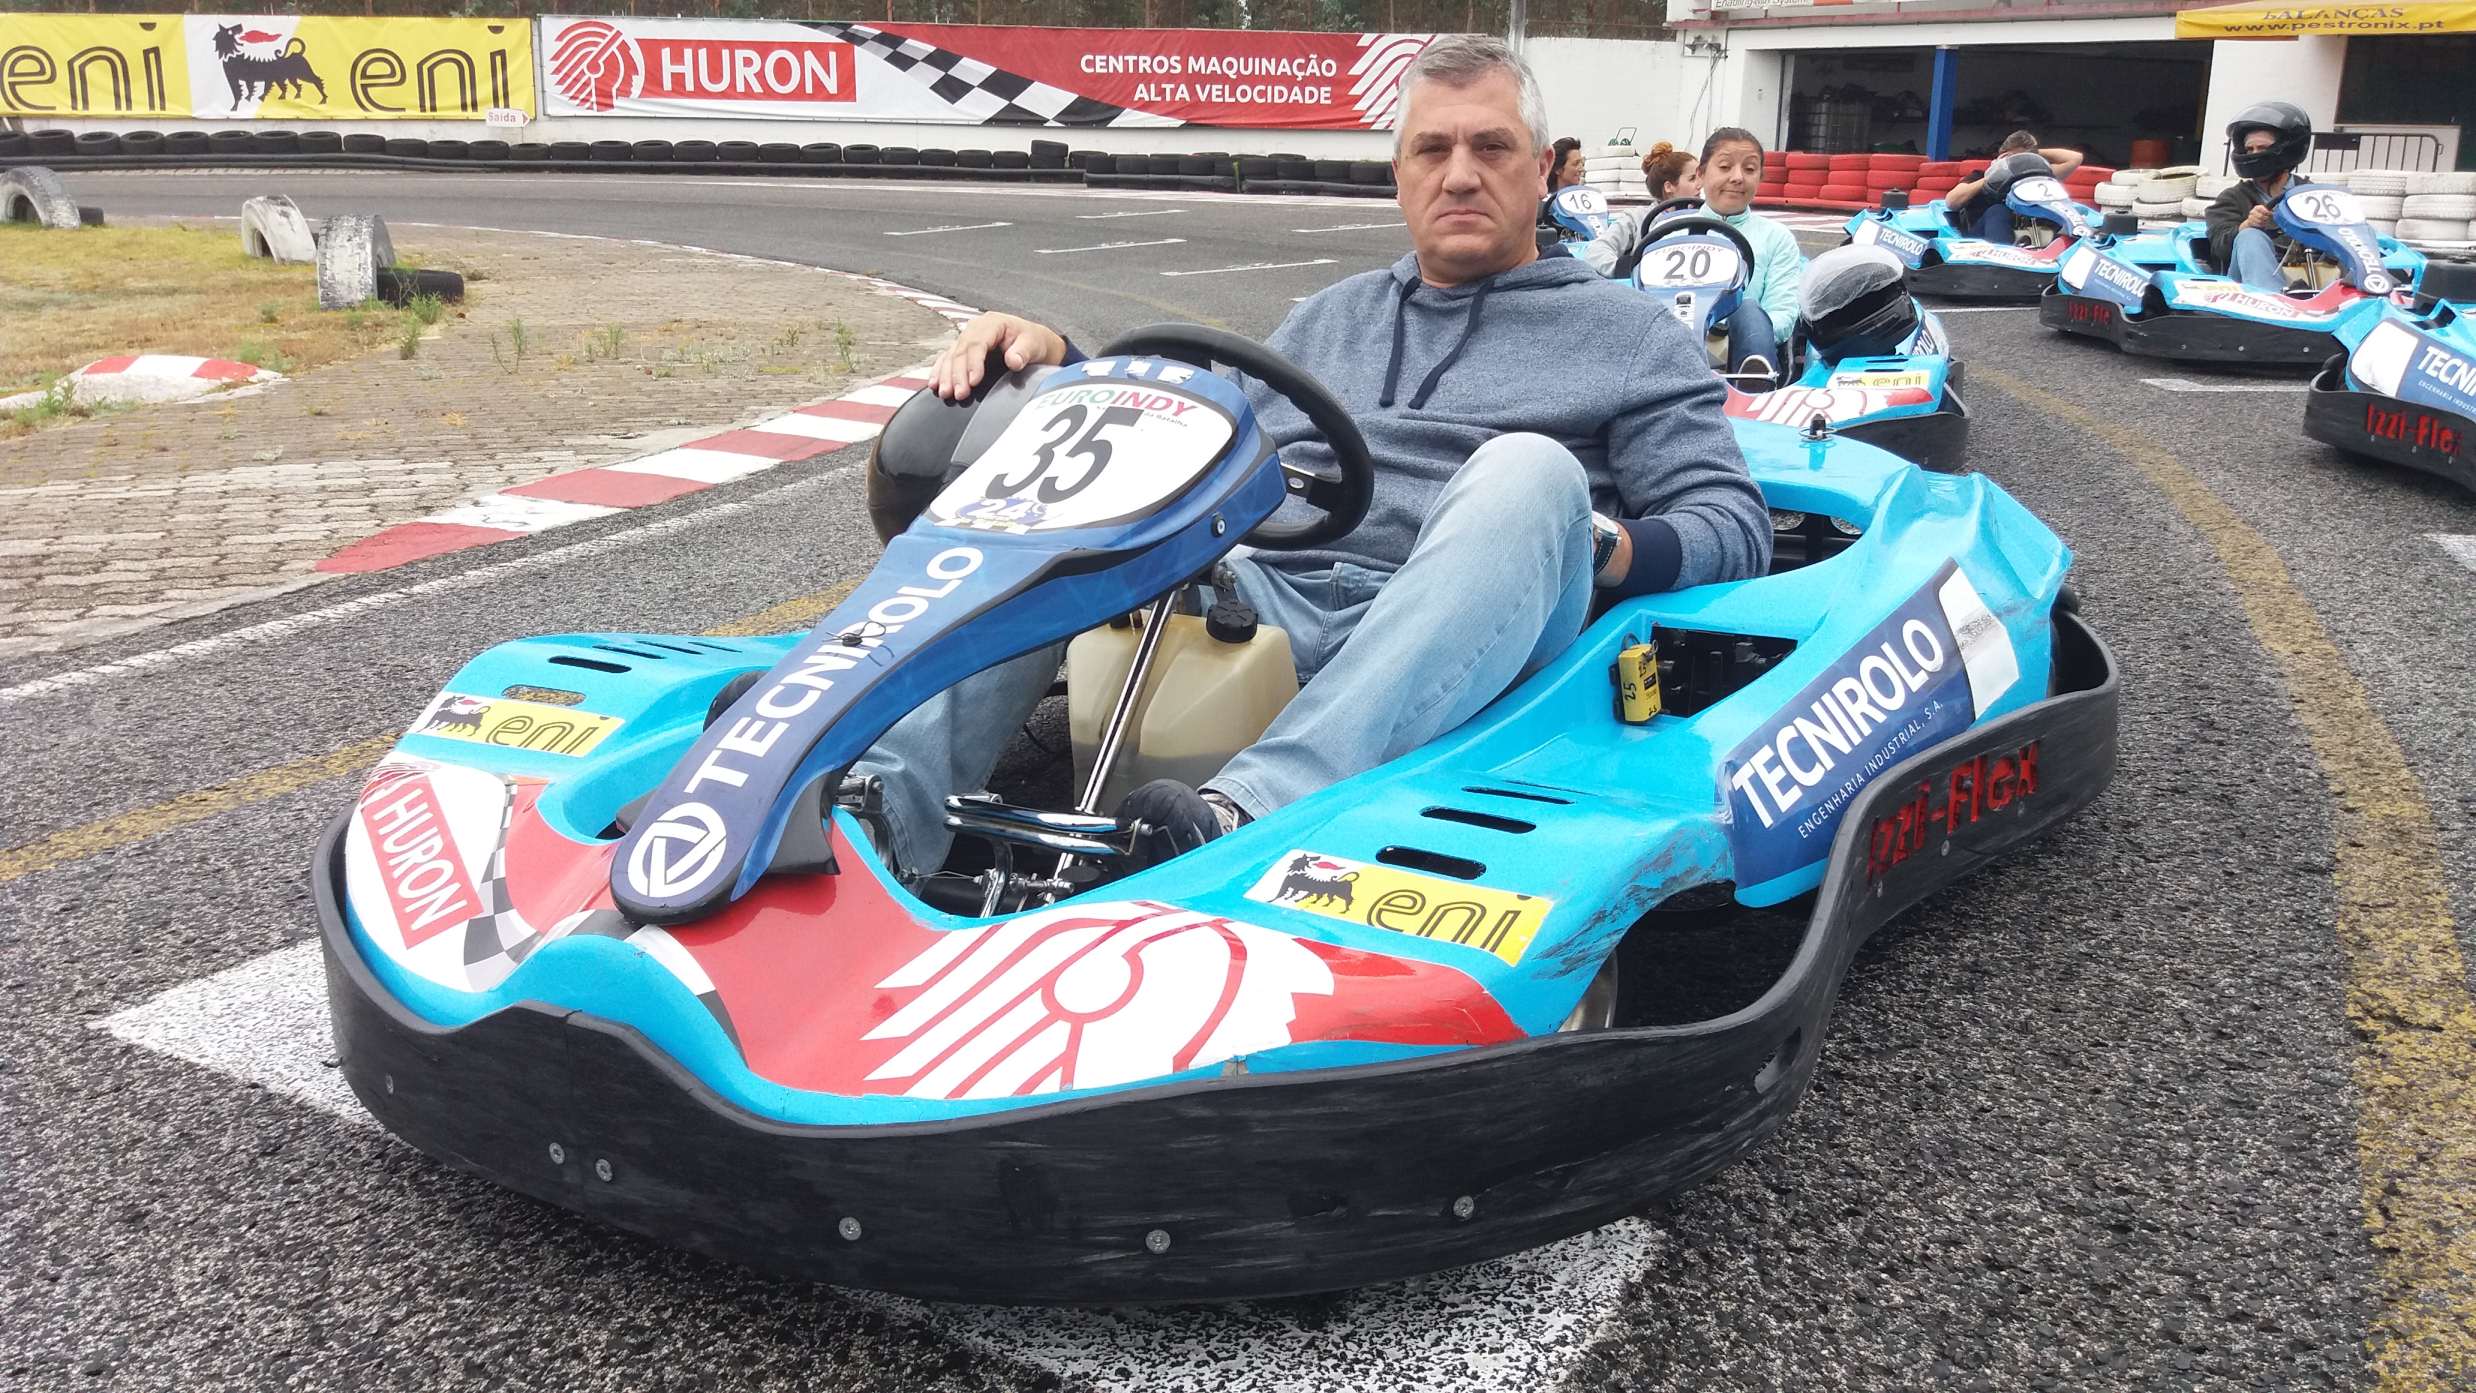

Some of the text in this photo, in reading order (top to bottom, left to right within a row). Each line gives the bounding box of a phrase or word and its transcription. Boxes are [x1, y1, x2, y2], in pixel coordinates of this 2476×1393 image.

[2223, 20, 2445, 33] www.pestronix.pt
[1, 22, 167, 111] eni
[350, 25, 511, 112] eni
[661, 47, 838, 95] HURON
[1080, 53, 1338, 81] CENTROS MAQUINAÇÃO
[1133, 83, 1332, 105] ALTA VELOCIDADE
[1569, 193, 1592, 210] 16
[2305, 194, 2341, 220] 26
[1879, 228, 1924, 256] TECNIROLO
[1664, 249, 1712, 281] 20
[984, 403, 1145, 504] 35
[683, 547, 984, 794] TECNIROLO
[1623, 682, 1637, 701] 25
[486, 714, 610, 754] eni
[1732, 618, 1944, 830] TECNIROLO
[1798, 773, 1866, 839] ENGENHARIA
[372, 787, 468, 932] HURON
[1367, 889, 1531, 953] eni
